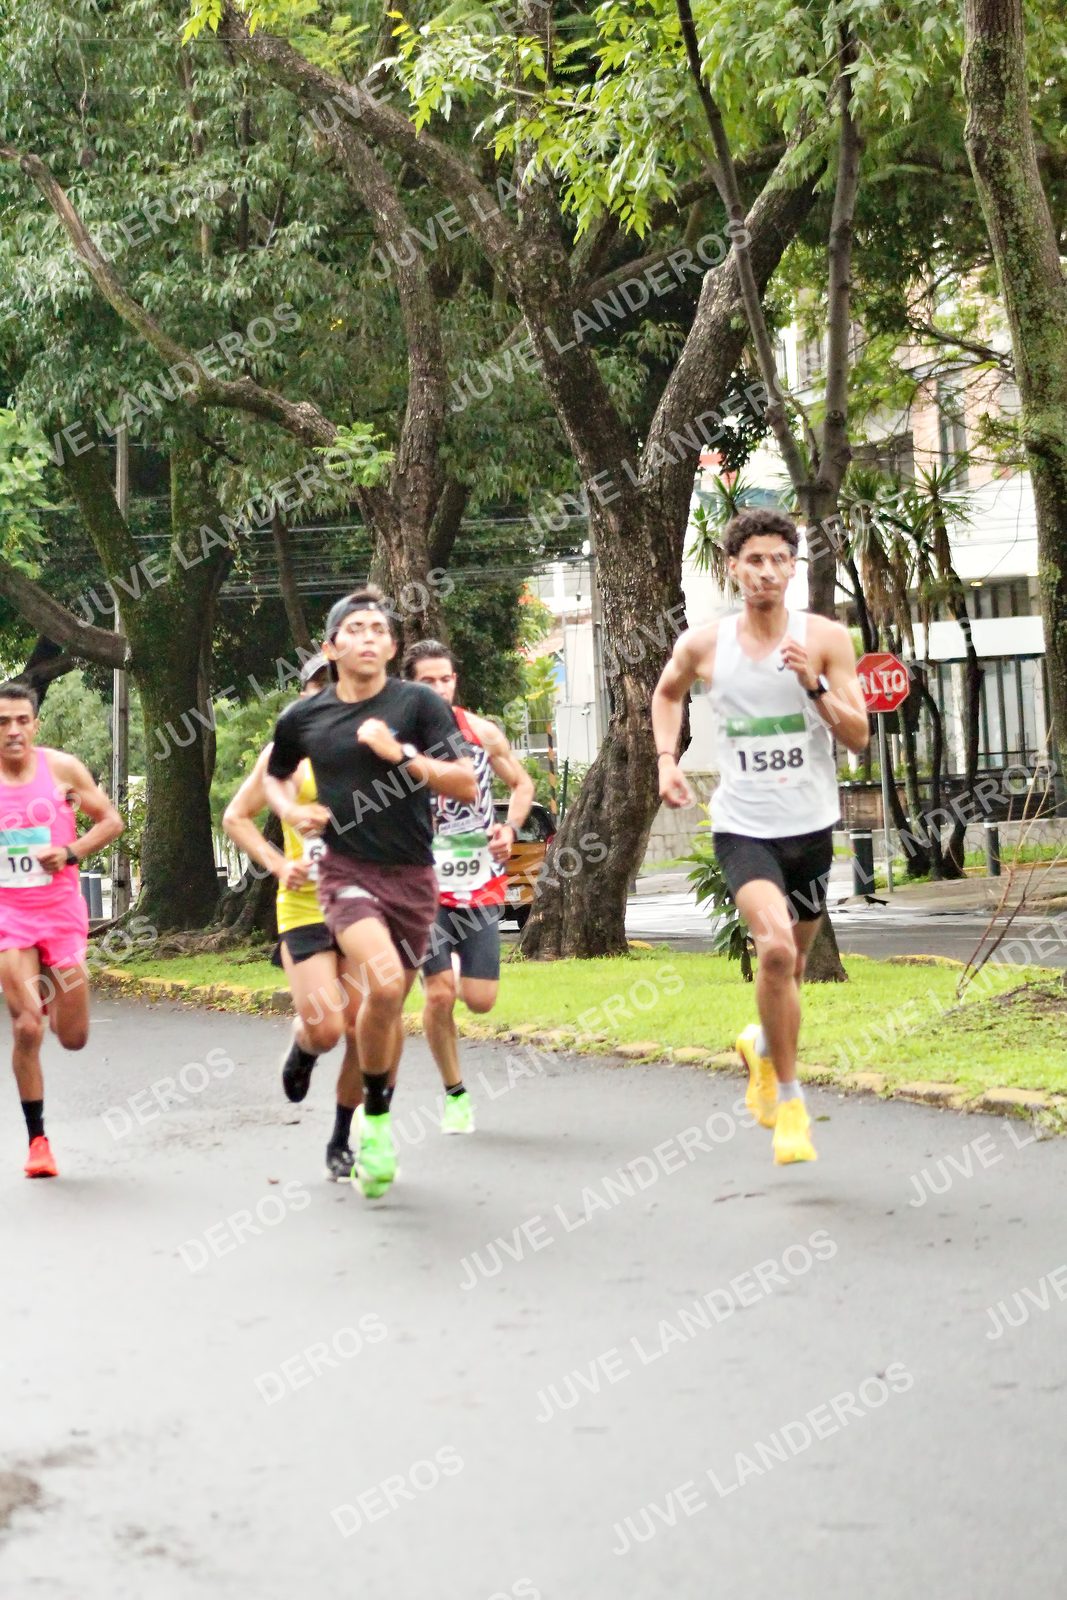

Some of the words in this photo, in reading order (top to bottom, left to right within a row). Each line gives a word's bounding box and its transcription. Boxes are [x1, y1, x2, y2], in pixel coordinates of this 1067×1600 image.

[858, 669, 906, 695] ALTO
[737, 747, 804, 772] 1588
[8, 856, 33, 873] 10
[441, 859, 481, 877] 999
